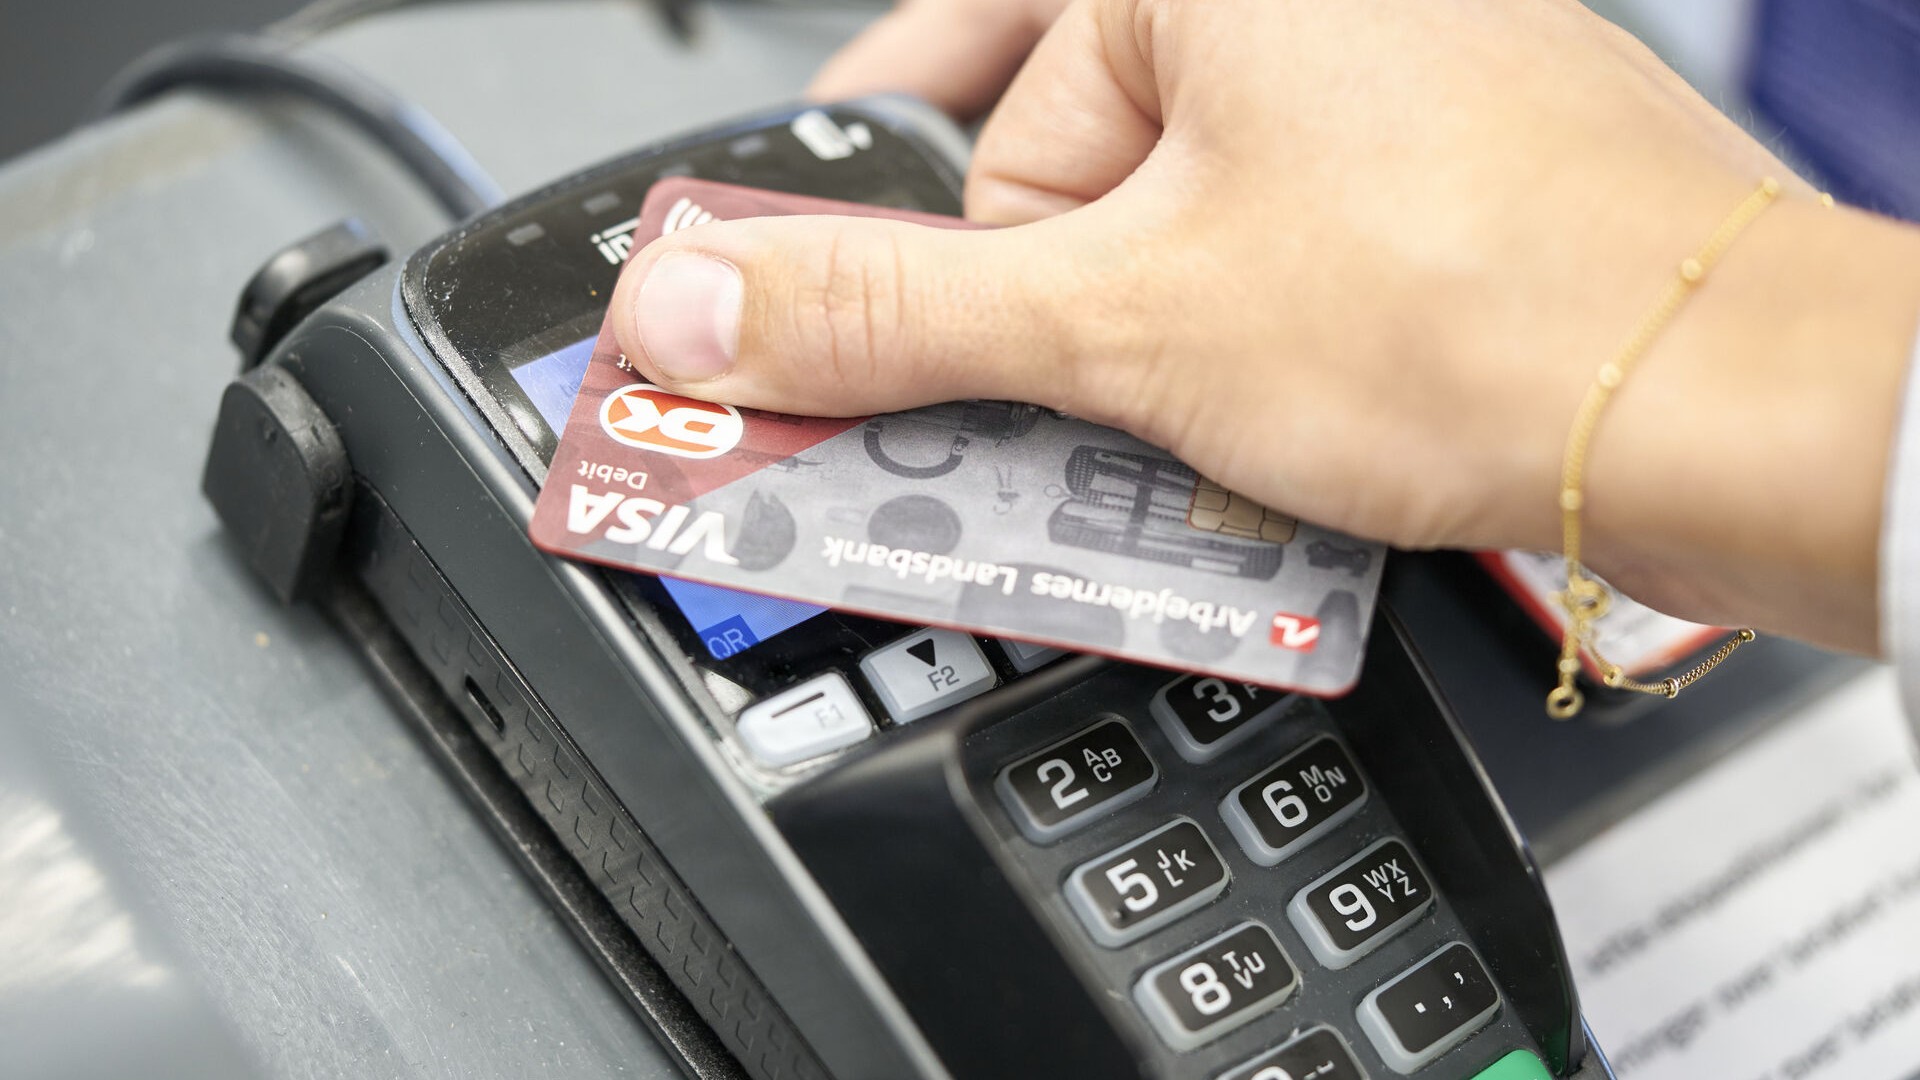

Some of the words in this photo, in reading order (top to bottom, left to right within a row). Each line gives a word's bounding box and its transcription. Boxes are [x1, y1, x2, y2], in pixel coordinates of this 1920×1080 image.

[577, 459, 648, 490] Debit
[565, 483, 739, 566] VISA
[820, 533, 1017, 594] Landsbank
[1031, 570, 1258, 638] Arbejdernes
[926, 664, 961, 692] F2
[1192, 677, 1241, 723] 3
[815, 703, 845, 729] F1
[1037, 758, 1090, 810] 2
[1262, 779, 1308, 828] 6
[1105, 858, 1159, 912] 5
[1328, 883, 1377, 932] 9
[1179, 962, 1232, 1016] 8
